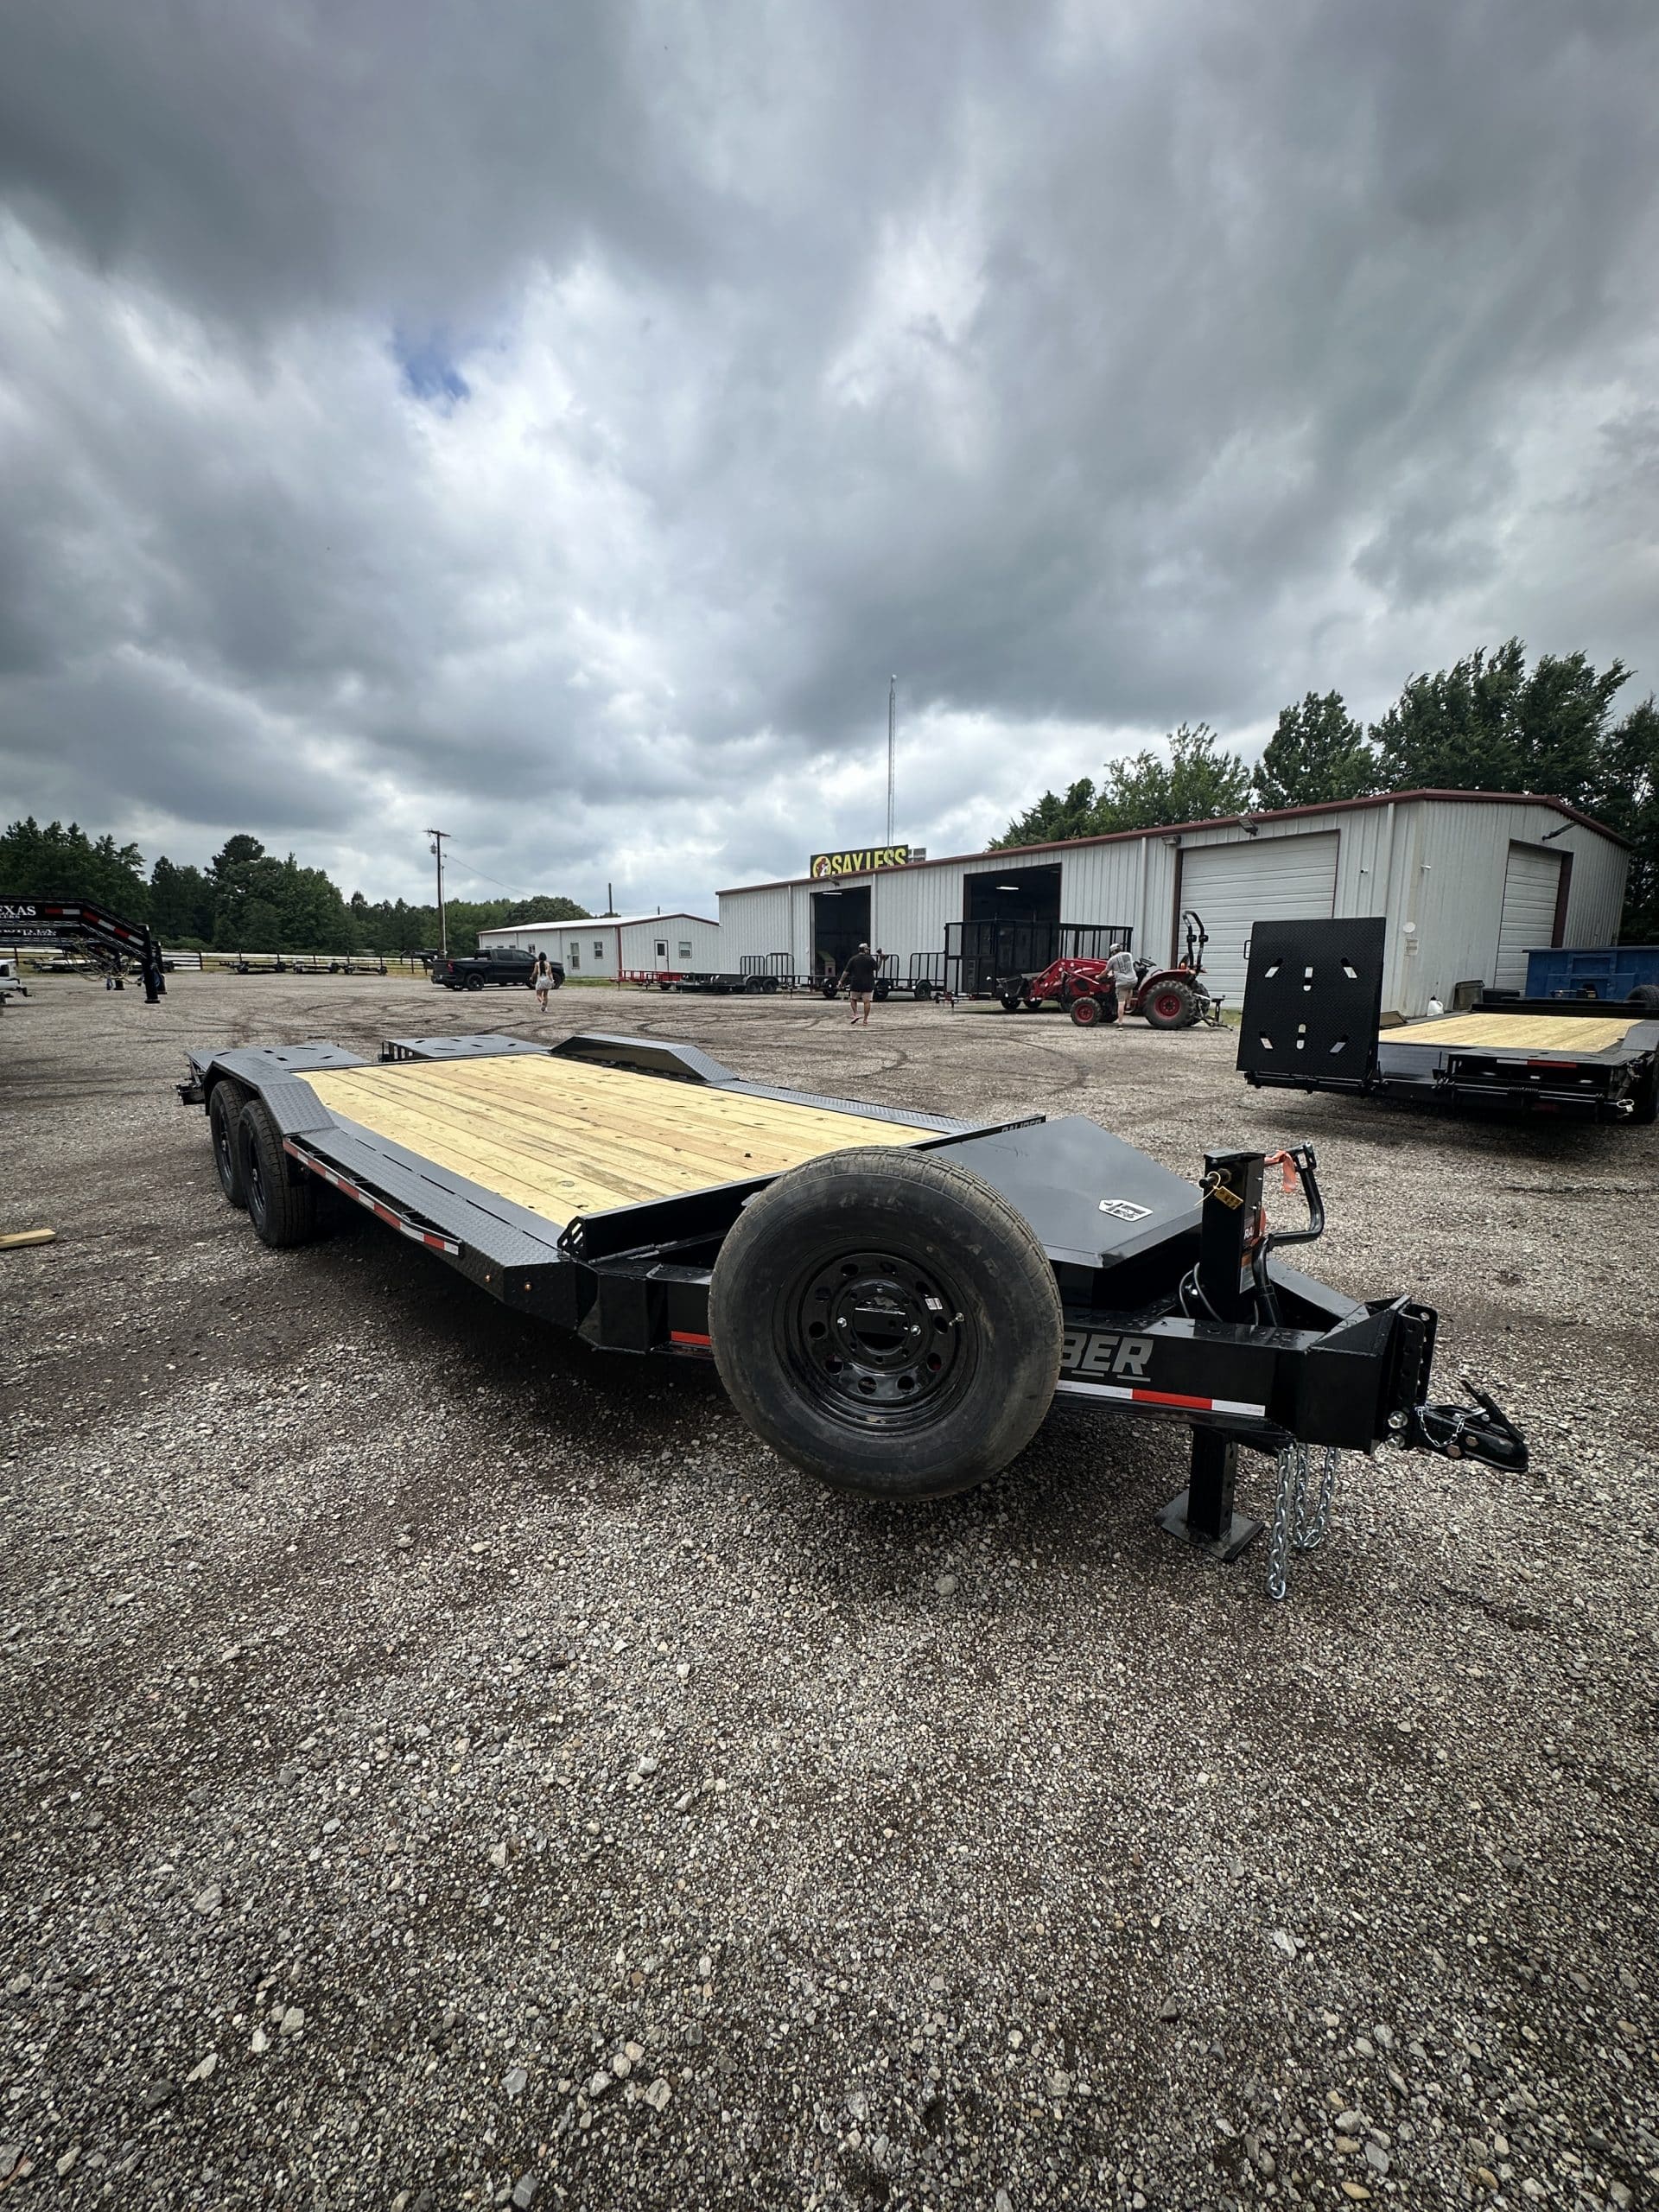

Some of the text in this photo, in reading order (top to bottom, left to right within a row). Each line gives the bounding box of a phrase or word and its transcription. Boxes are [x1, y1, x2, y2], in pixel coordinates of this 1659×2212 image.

[832, 852, 863, 875] SAY
[0, 905, 36, 916] EXAS
[1061, 1332, 1154, 1376] BER
